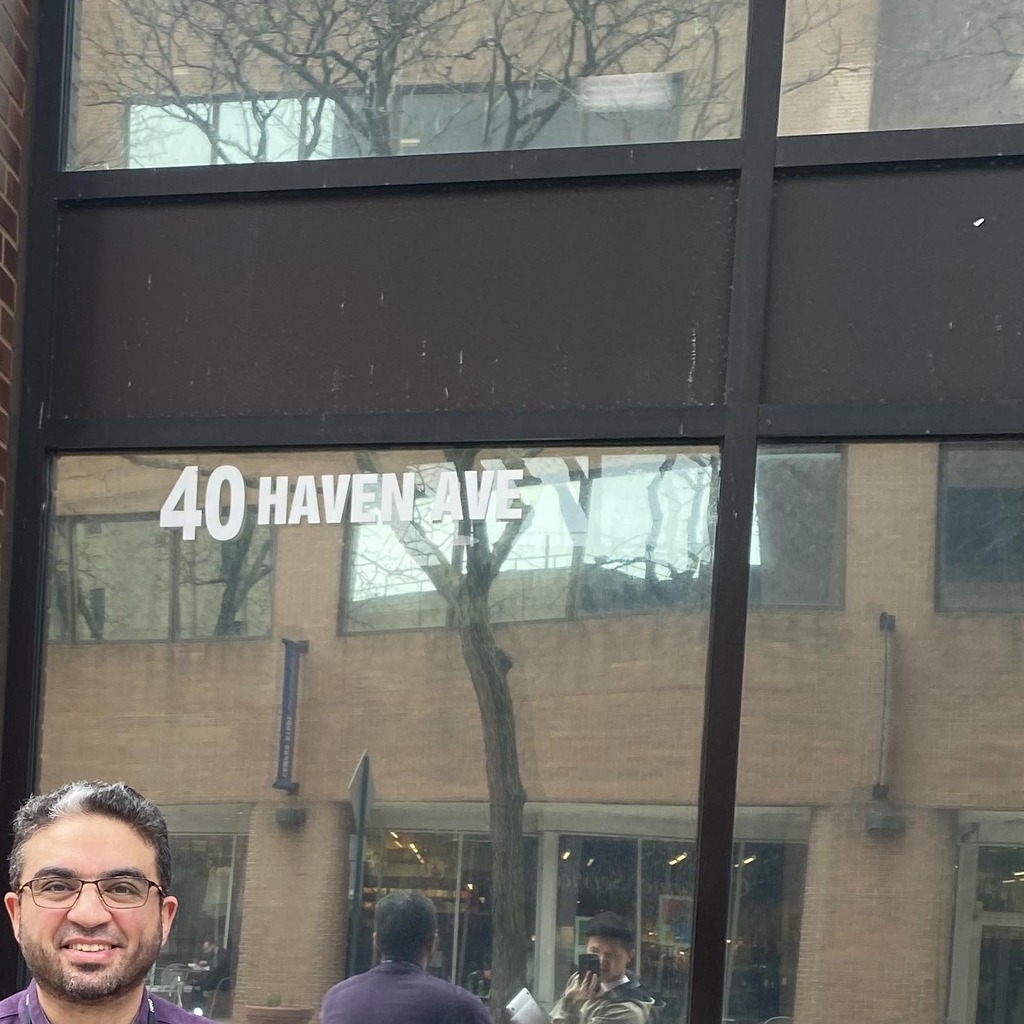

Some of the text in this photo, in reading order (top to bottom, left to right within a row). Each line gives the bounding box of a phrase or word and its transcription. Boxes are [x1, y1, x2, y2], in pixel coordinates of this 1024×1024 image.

[159, 464, 524, 542] 40 HAVEN AVE
